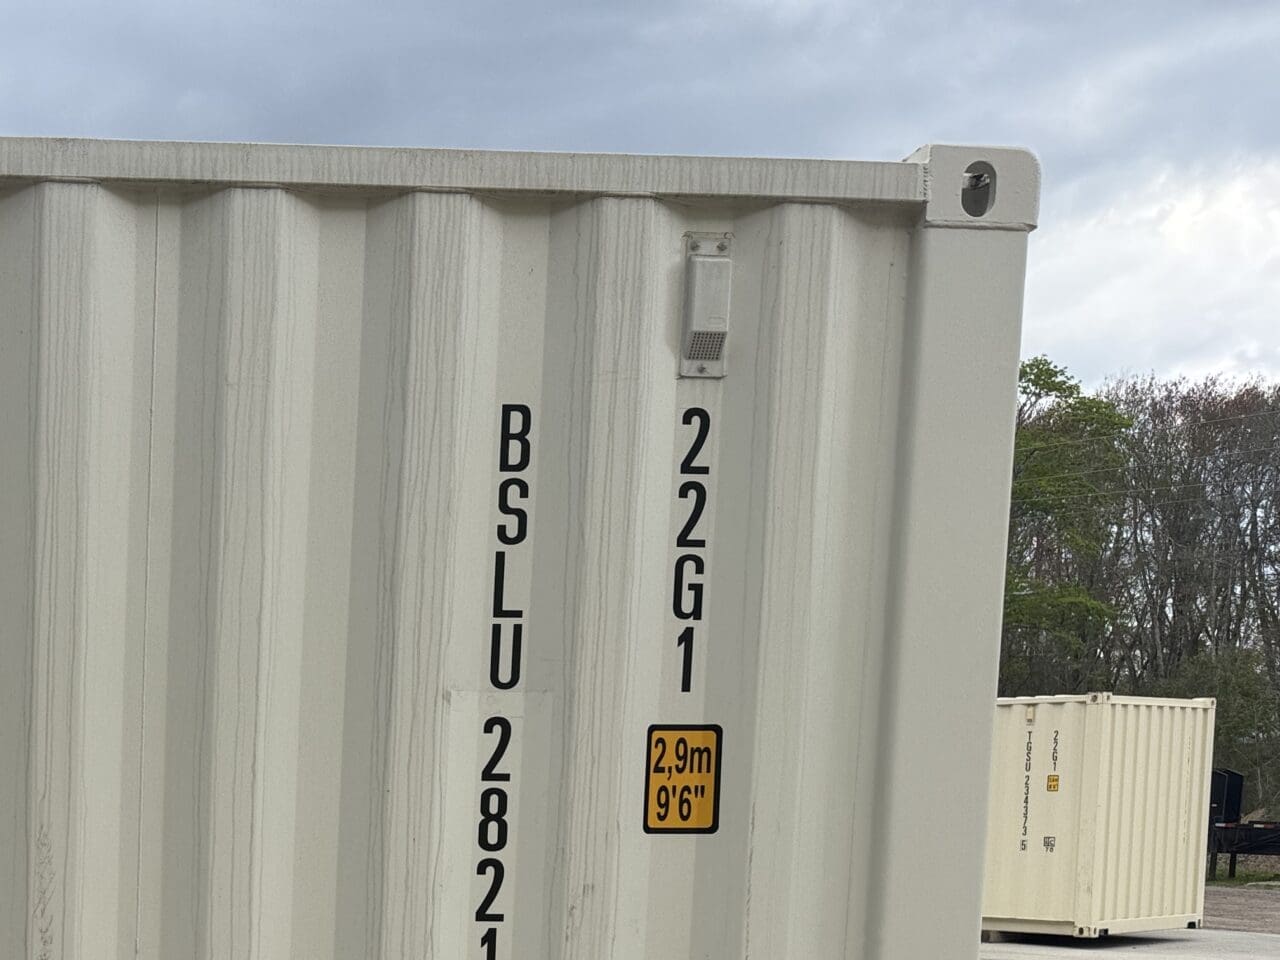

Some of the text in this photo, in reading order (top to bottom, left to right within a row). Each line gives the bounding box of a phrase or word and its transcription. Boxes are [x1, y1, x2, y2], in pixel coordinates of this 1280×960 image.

[490, 404, 532, 690] BSLU
[672, 407, 711, 693] 22G1
[653, 737, 712, 781] 2,9m
[656, 785, 705, 822] 9'6"
